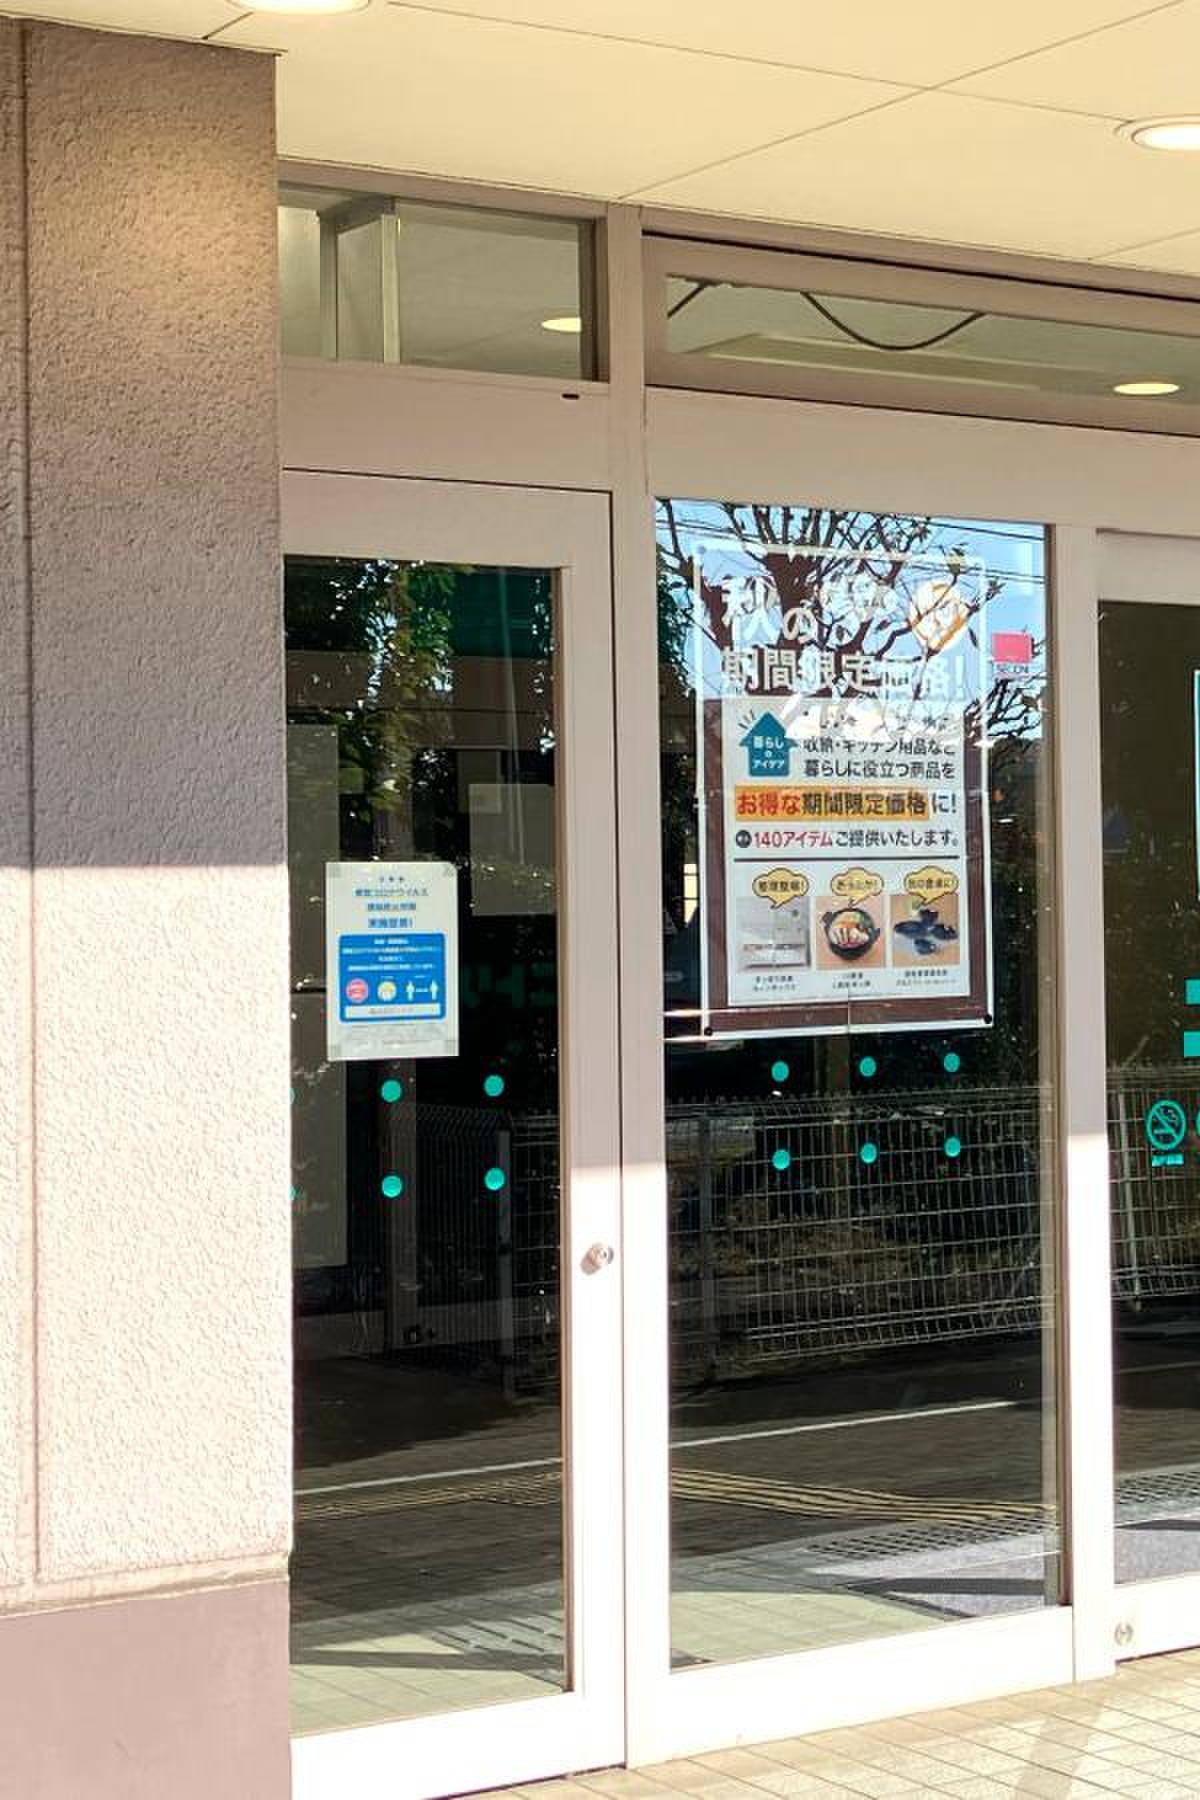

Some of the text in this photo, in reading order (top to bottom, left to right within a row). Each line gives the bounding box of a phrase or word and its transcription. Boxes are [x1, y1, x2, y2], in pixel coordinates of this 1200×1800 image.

[804, 759, 956, 780] 暮らしに役立つ商品を
[736, 789, 957, 816] お得な期間限定価格に!
